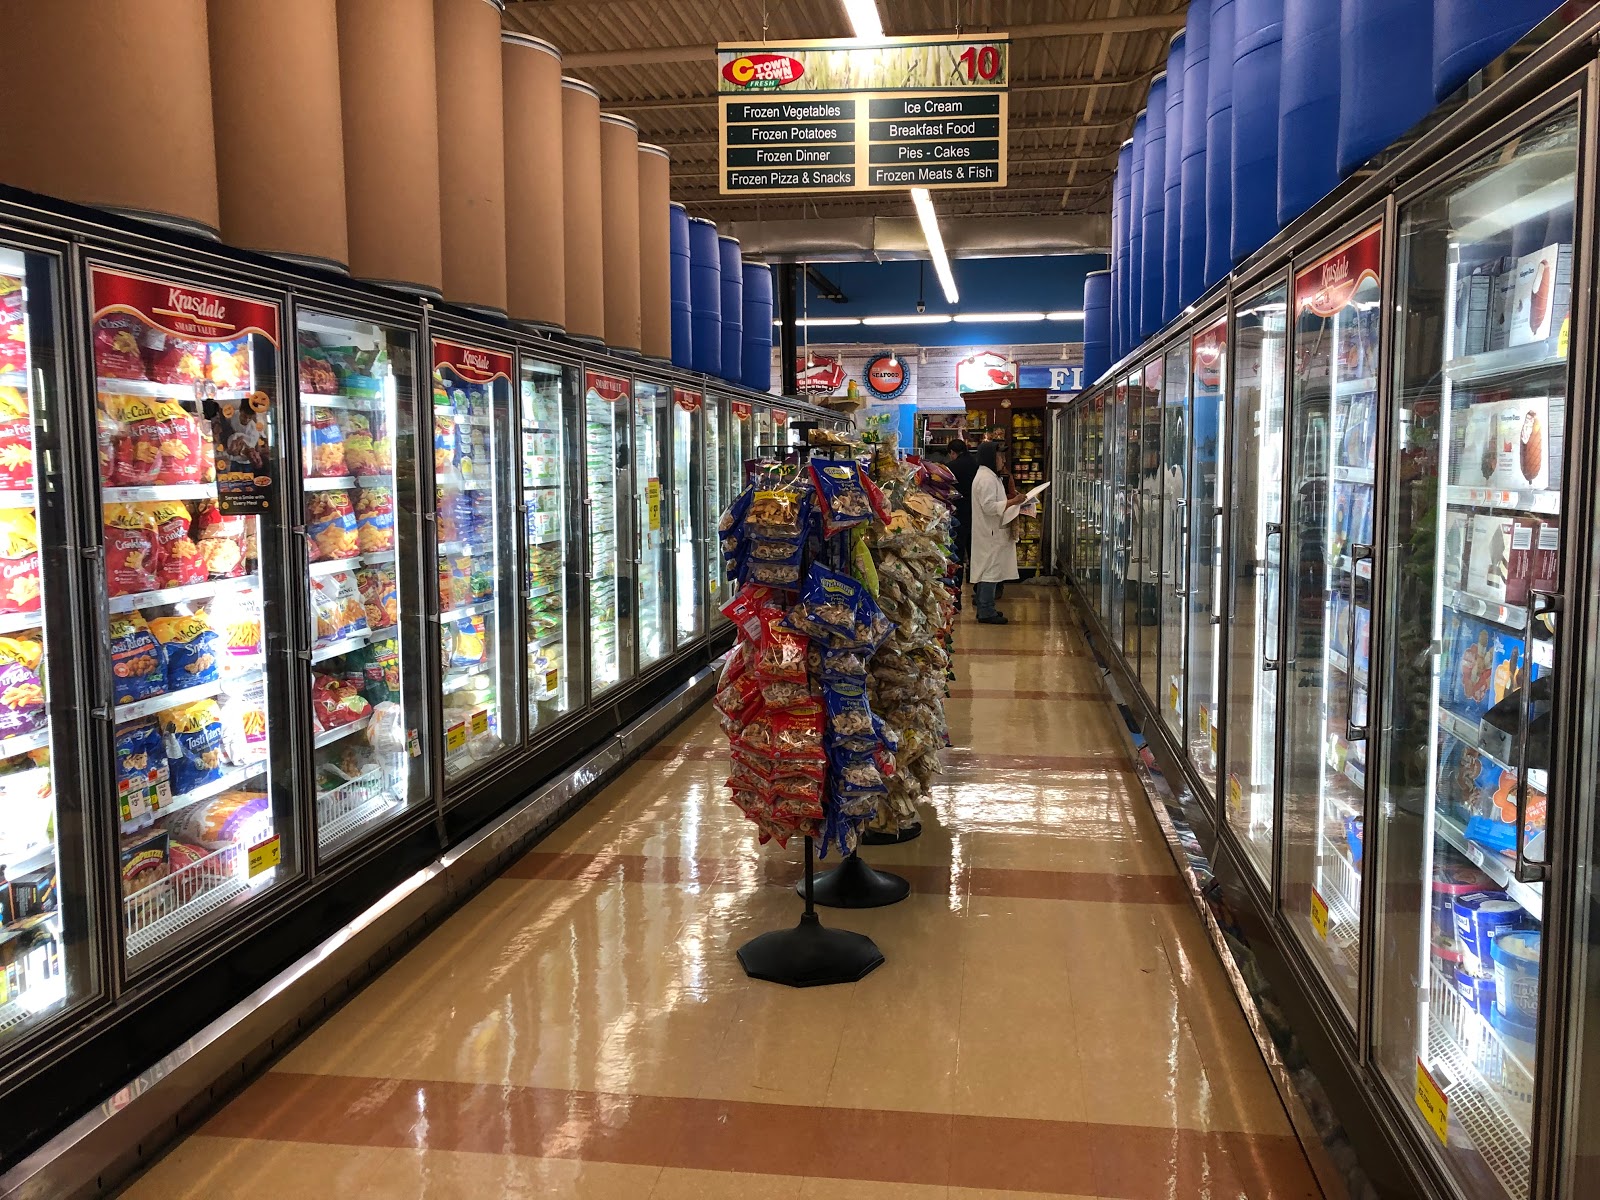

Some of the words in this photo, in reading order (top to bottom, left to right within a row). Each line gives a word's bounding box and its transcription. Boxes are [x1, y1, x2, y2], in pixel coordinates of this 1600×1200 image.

[959, 46, 999, 80] 10
[743, 105, 780, 118] Frozen
[782, 104, 841, 120] Vegetables
[904, 101, 921, 114] Ice
[924, 100, 963, 113] Cream
[751, 128, 788, 140] Frozen
[791, 127, 837, 139] Potatoes
[889, 123, 943, 137] Breakfast
[946, 121, 975, 135] Food
[756, 150, 793, 162] Frozen
[795, 149, 831, 161] Dinner
[898, 146, 923, 159] Pies
[934, 145, 970, 158] Cakes
[731, 173, 768, 185] Frozen
[770, 172, 799, 184] Pizza
[802, 171, 810, 184] &
[813, 171, 852, 184] Snacks
[876, 169, 915, 182] Frozen
[918, 168, 953, 180] Meats
[956, 166, 965, 179] &
[968, 165, 993, 178] Fish
[168, 288, 225, 319] Krasdale
[174, 321, 197, 333] SMART
[197, 325, 217, 336] VALUE
[463, 350, 490, 370] Krasdale
[117, 405, 154, 421] McCain
[181, 622, 209, 640] McCain
[186, 735, 206, 750] Tasti
